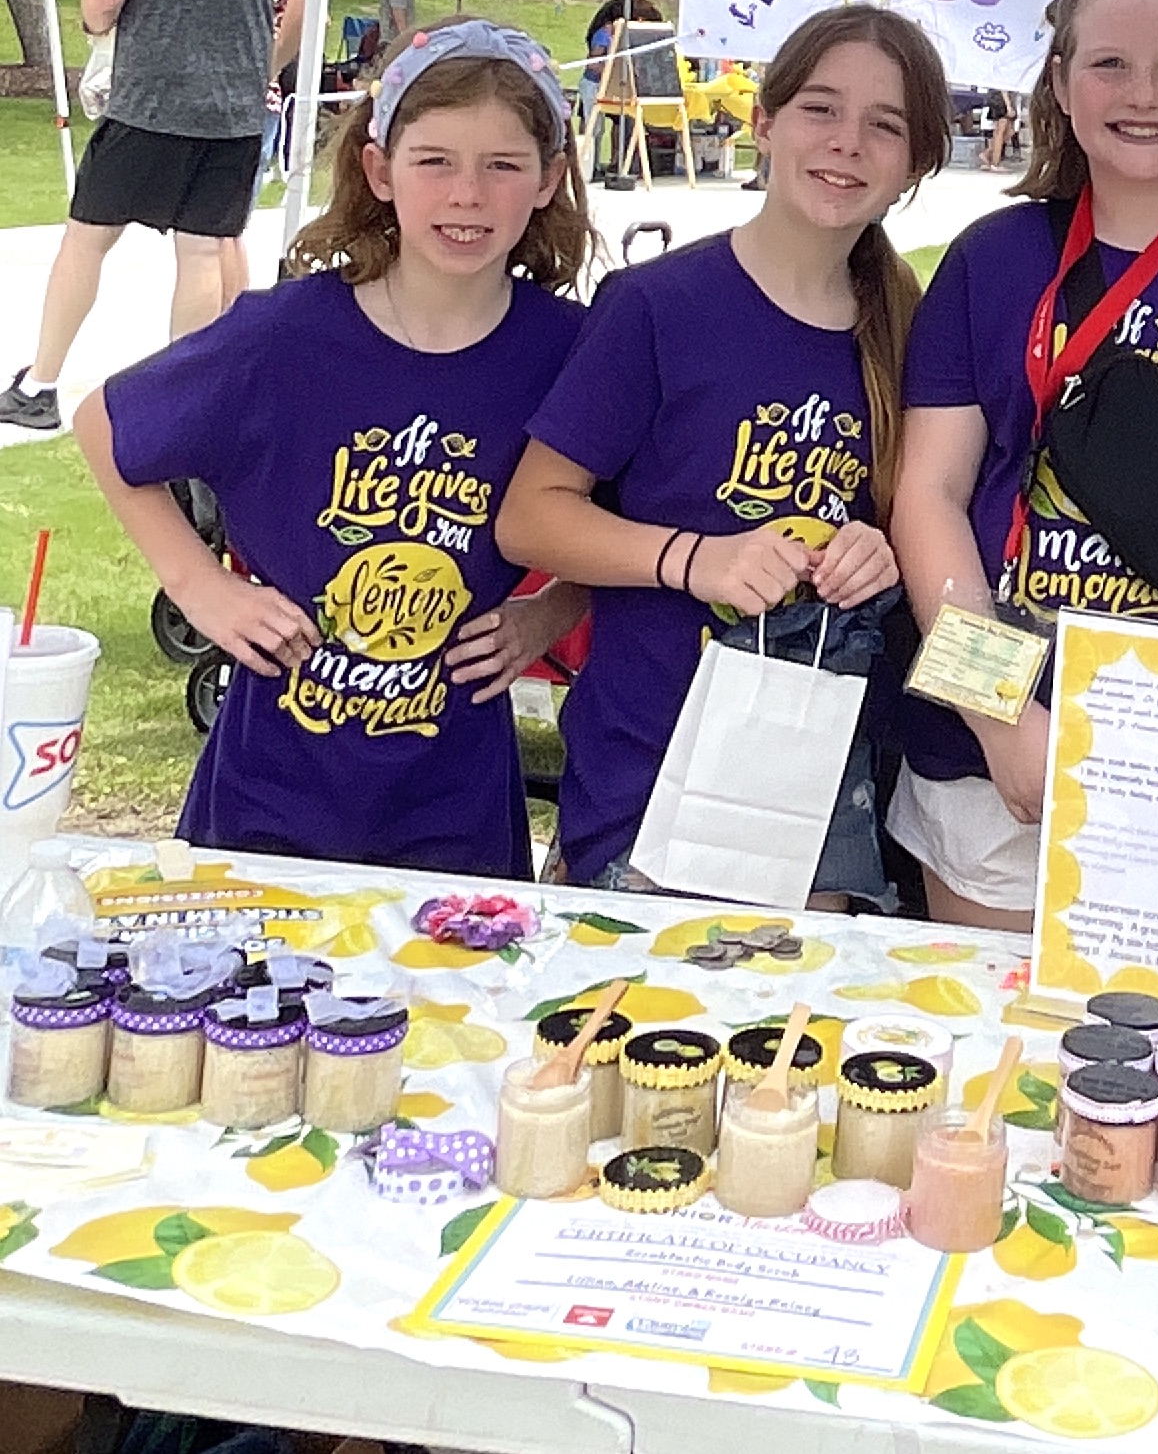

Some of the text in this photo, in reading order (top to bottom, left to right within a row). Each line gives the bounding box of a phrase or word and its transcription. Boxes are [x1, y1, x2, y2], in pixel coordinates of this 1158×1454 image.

[393, 415, 438, 467] If
[792, 393, 830, 442] If
[717, 419, 868, 511] Life gives
[317, 446, 492, 535] Life gives
[818, 494, 850, 525] yo
[427, 517, 473, 553] you
[1038, 528, 1135, 575] ma
[279, 656, 448, 737] Lemonade
[1088, 901, 1141, 917] peppermint
[1130, 922, 1138, 933] A
[671, 1209, 733, 1224] NIOR
[557, 1229, 706, 1248] CERTIFICATE
[710, 1239, 740, 1253] OF
[744, 1245, 893, 1276] OCCUPANCY
